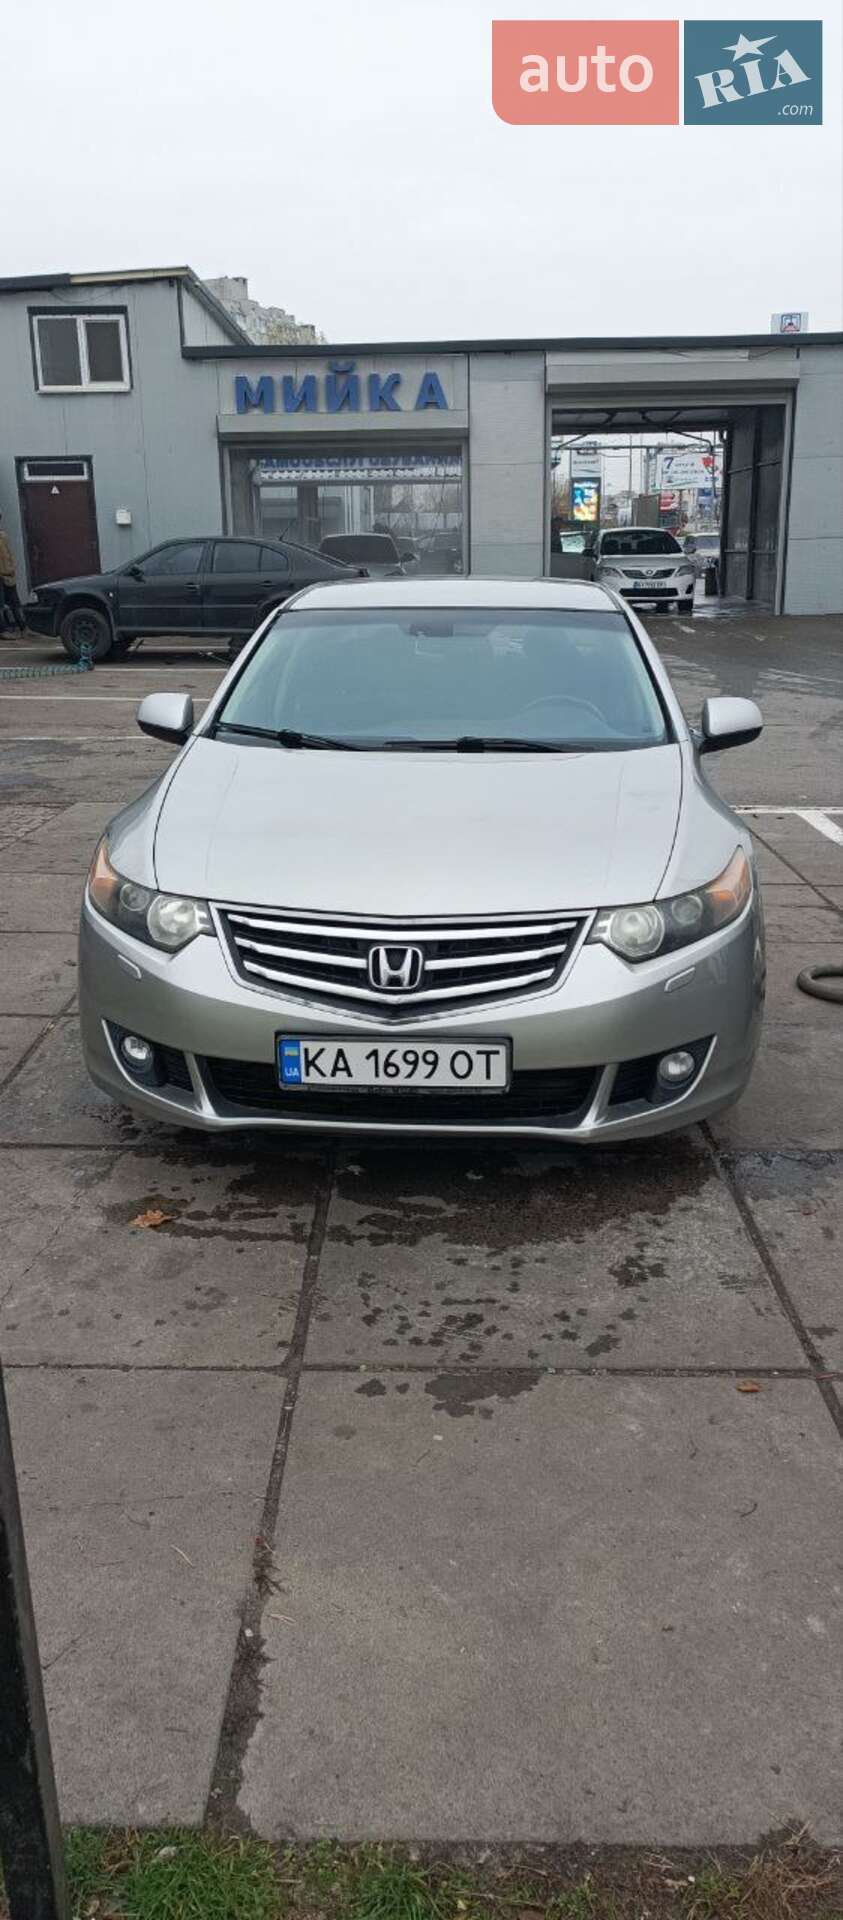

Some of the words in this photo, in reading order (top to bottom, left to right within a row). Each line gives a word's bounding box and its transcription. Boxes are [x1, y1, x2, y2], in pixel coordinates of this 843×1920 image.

[234, 360, 449, 415] МИЙКА
[664, 456, 674, 470] 7
[284, 1067, 299, 1078] UA
[304, 1047, 353, 1079] KA
[365, 1048, 440, 1080] 1699
[450, 1049, 500, 1080] OT
